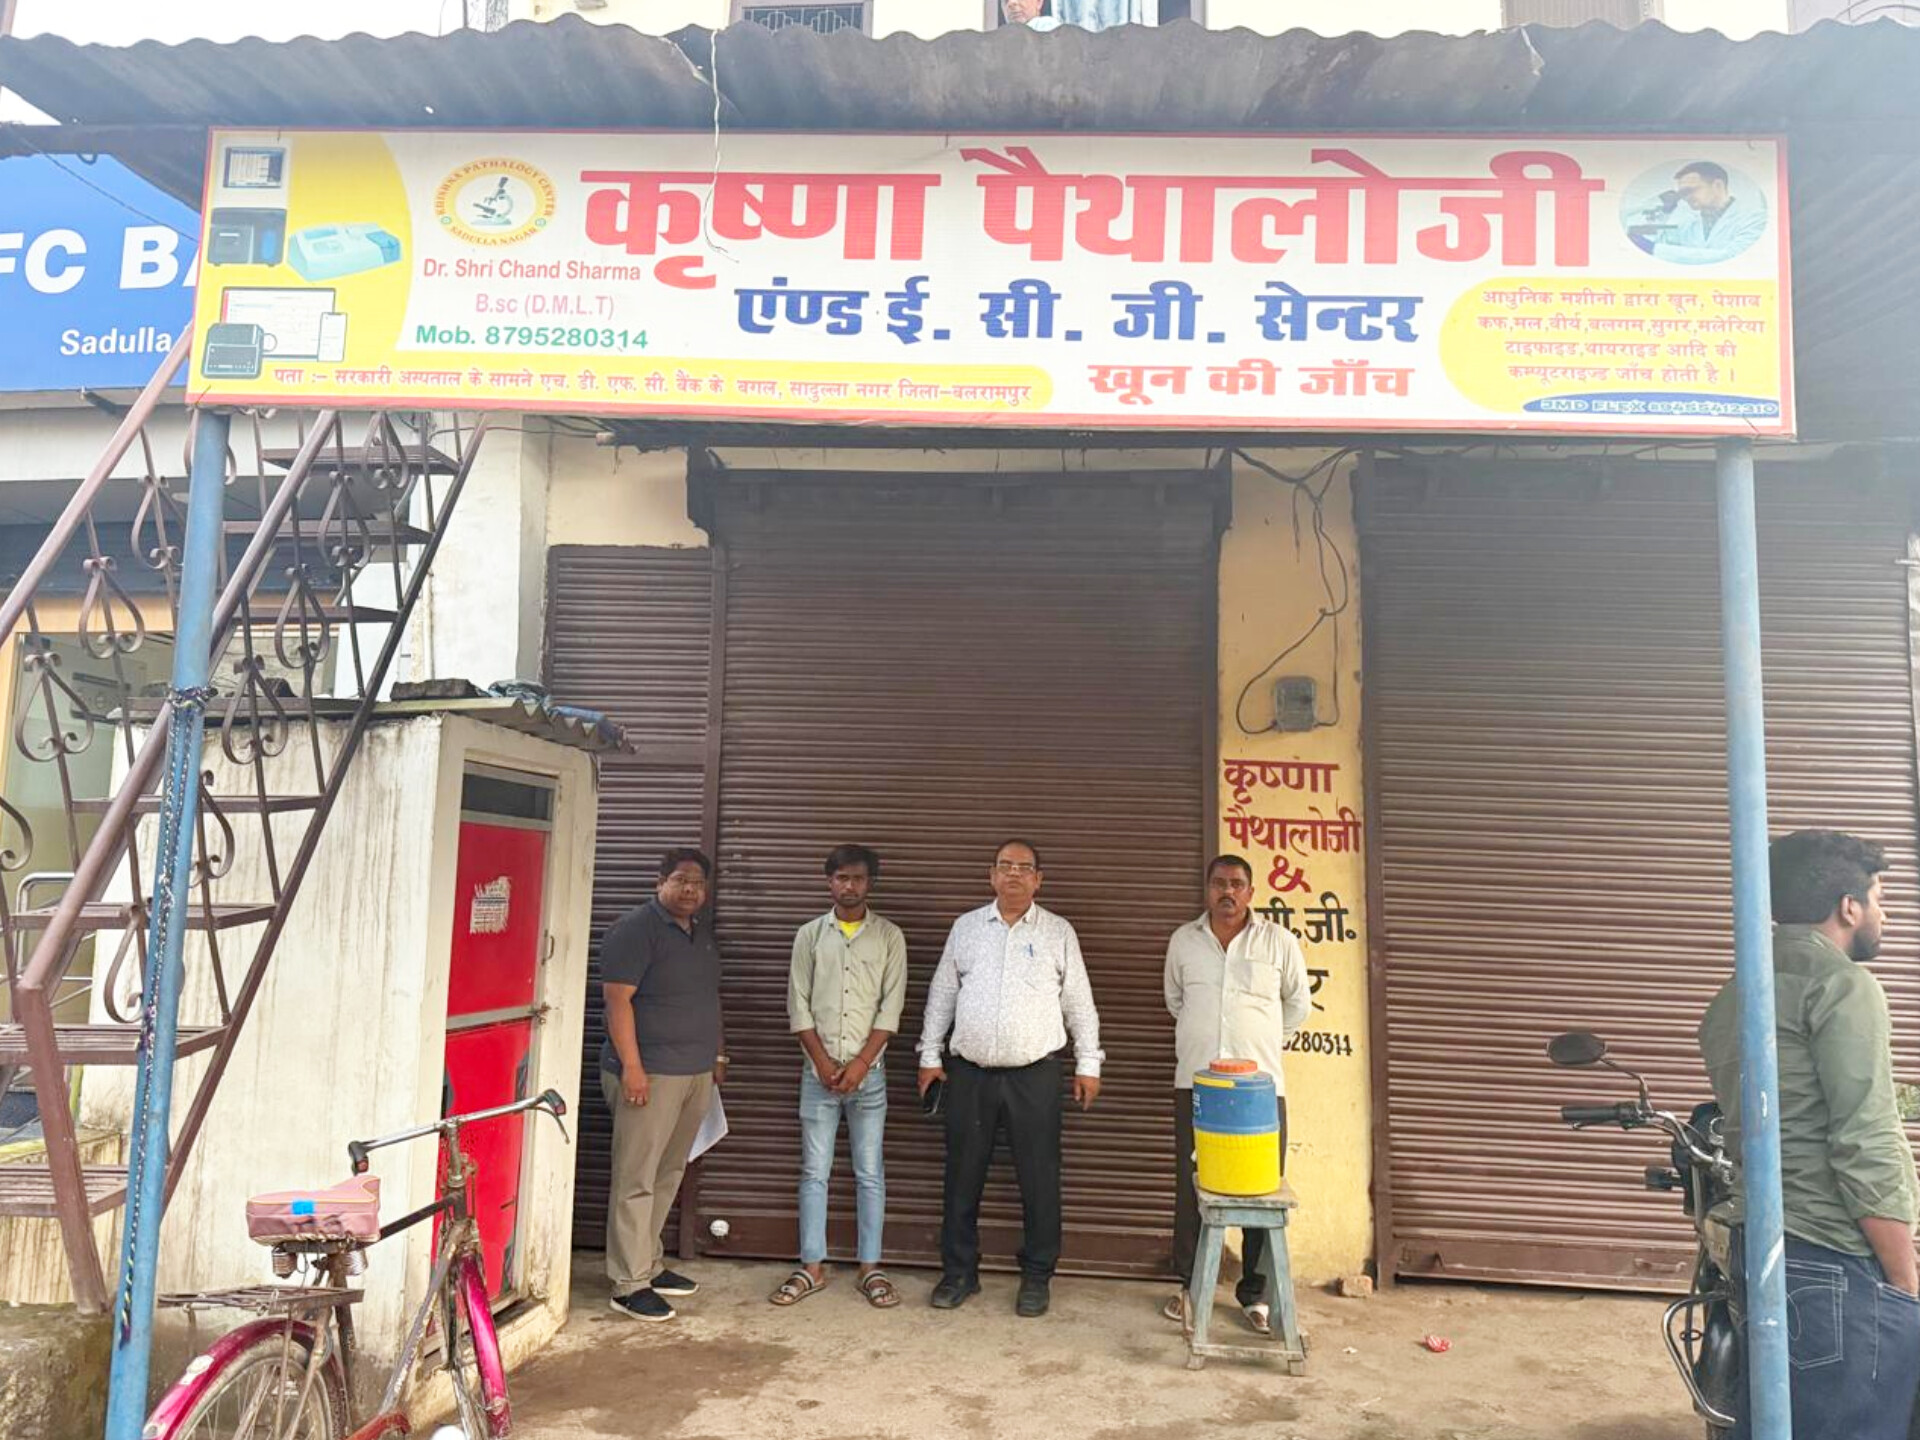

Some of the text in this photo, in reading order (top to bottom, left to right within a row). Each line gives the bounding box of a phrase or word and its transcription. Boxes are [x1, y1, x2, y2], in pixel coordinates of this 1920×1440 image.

[580, 146, 1605, 289] कृष्णा पैथालोजी
[119, 225, 200, 289] B
[423, 258, 641, 281] Dr. Shri Chand Sharma
[475, 293, 615, 320] B.sc (D.M.L.T)
[979, 278, 1083, 342] सी.
[1111, 280, 1226, 343] जी.
[1254, 281, 1423, 342] सेन्टर
[60, 327, 173, 355] Sadulla
[416, 325, 648, 349] Mob. 8795280314
[273, 369, 304, 383] पता
[335, 365, 393, 384] सरकारी
[399, 371, 462, 386] अस्पताल
[488, 368, 533, 387] सामने
[856, 382, 891, 398] नगर
[1087, 364, 1193, 406] खून
[1205, 357, 1283, 396] की
[1592, 400, 1647, 413] FLEX
[1223, 759, 1341, 804] कृष्णा
[1223, 803, 1362, 858] पैथालोजी
[1268, 854, 1312, 893] &
[1283, 1031, 1352, 1057] 280314
